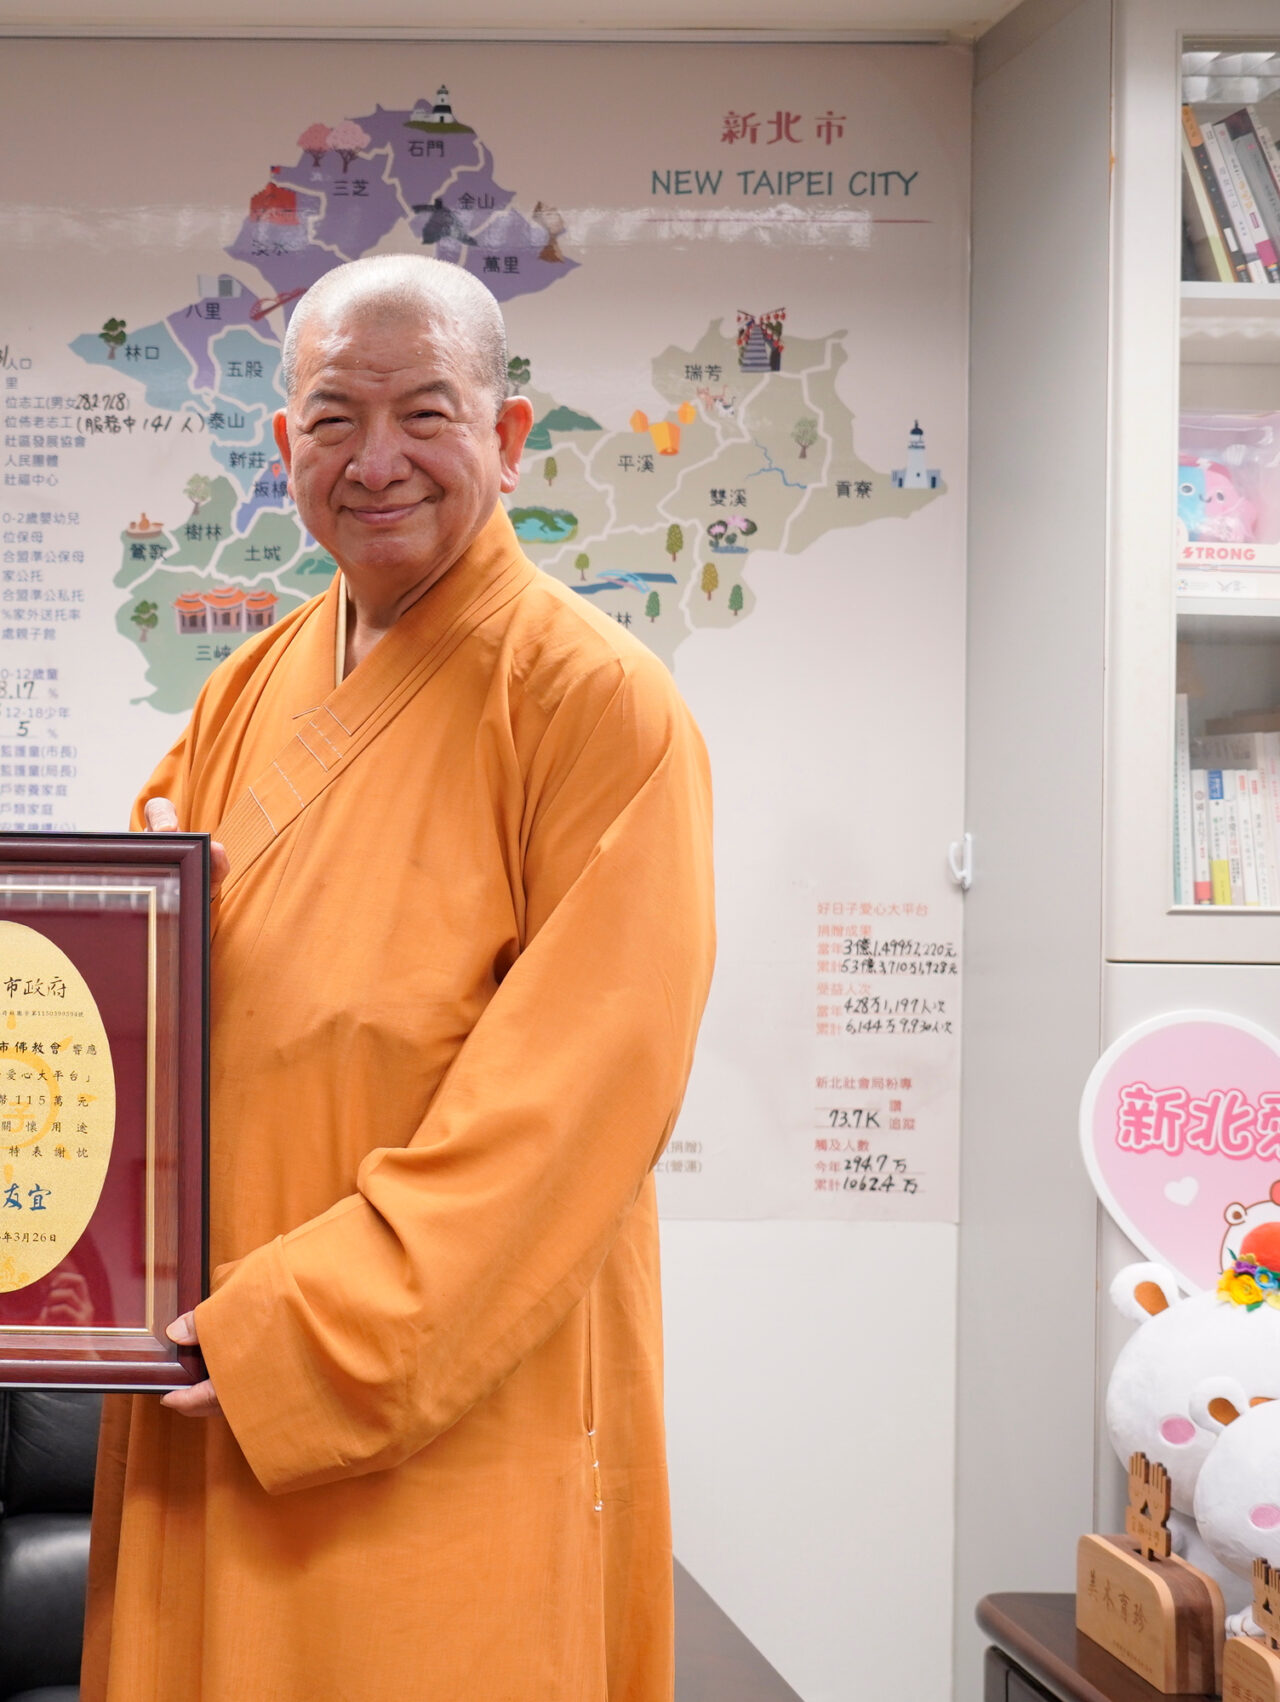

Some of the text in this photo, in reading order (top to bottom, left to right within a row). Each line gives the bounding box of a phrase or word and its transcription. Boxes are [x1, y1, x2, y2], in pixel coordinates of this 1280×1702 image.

[720, 110, 847, 146] 新北市
[408, 140, 445, 157] 石門
[333, 180, 369, 197] 三芝
[651, 170, 918, 196] NEW TAIPEI CITY
[457, 192, 495, 210] 金山
[482, 256, 520, 274] 萬里
[186, 302, 221, 320] 八里
[125, 345, 160, 361] 林口
[8, 358, 32, 370] 人口
[227, 361, 263, 379] 五股
[684, 364, 722, 382] 瑞芳
[6, 377, 18, 388] 里
[207, 413, 245, 430] 泰山
[5, 435, 86, 448] 社區發展協會
[229, 452, 265, 469] 新莊
[617, 455, 654, 473] 平溪
[709, 488, 747, 507] 雙溪
[835, 480, 873, 499] 貢寮
[185, 524, 222, 541] 樹林
[129, 544, 167, 561] 鶯歌
[244, 545, 280, 562] 土城
[16, 720, 31, 737] 5
[72, 1044, 98, 1056] 響應
[9, 1146, 89, 1159] 特表謝忱
